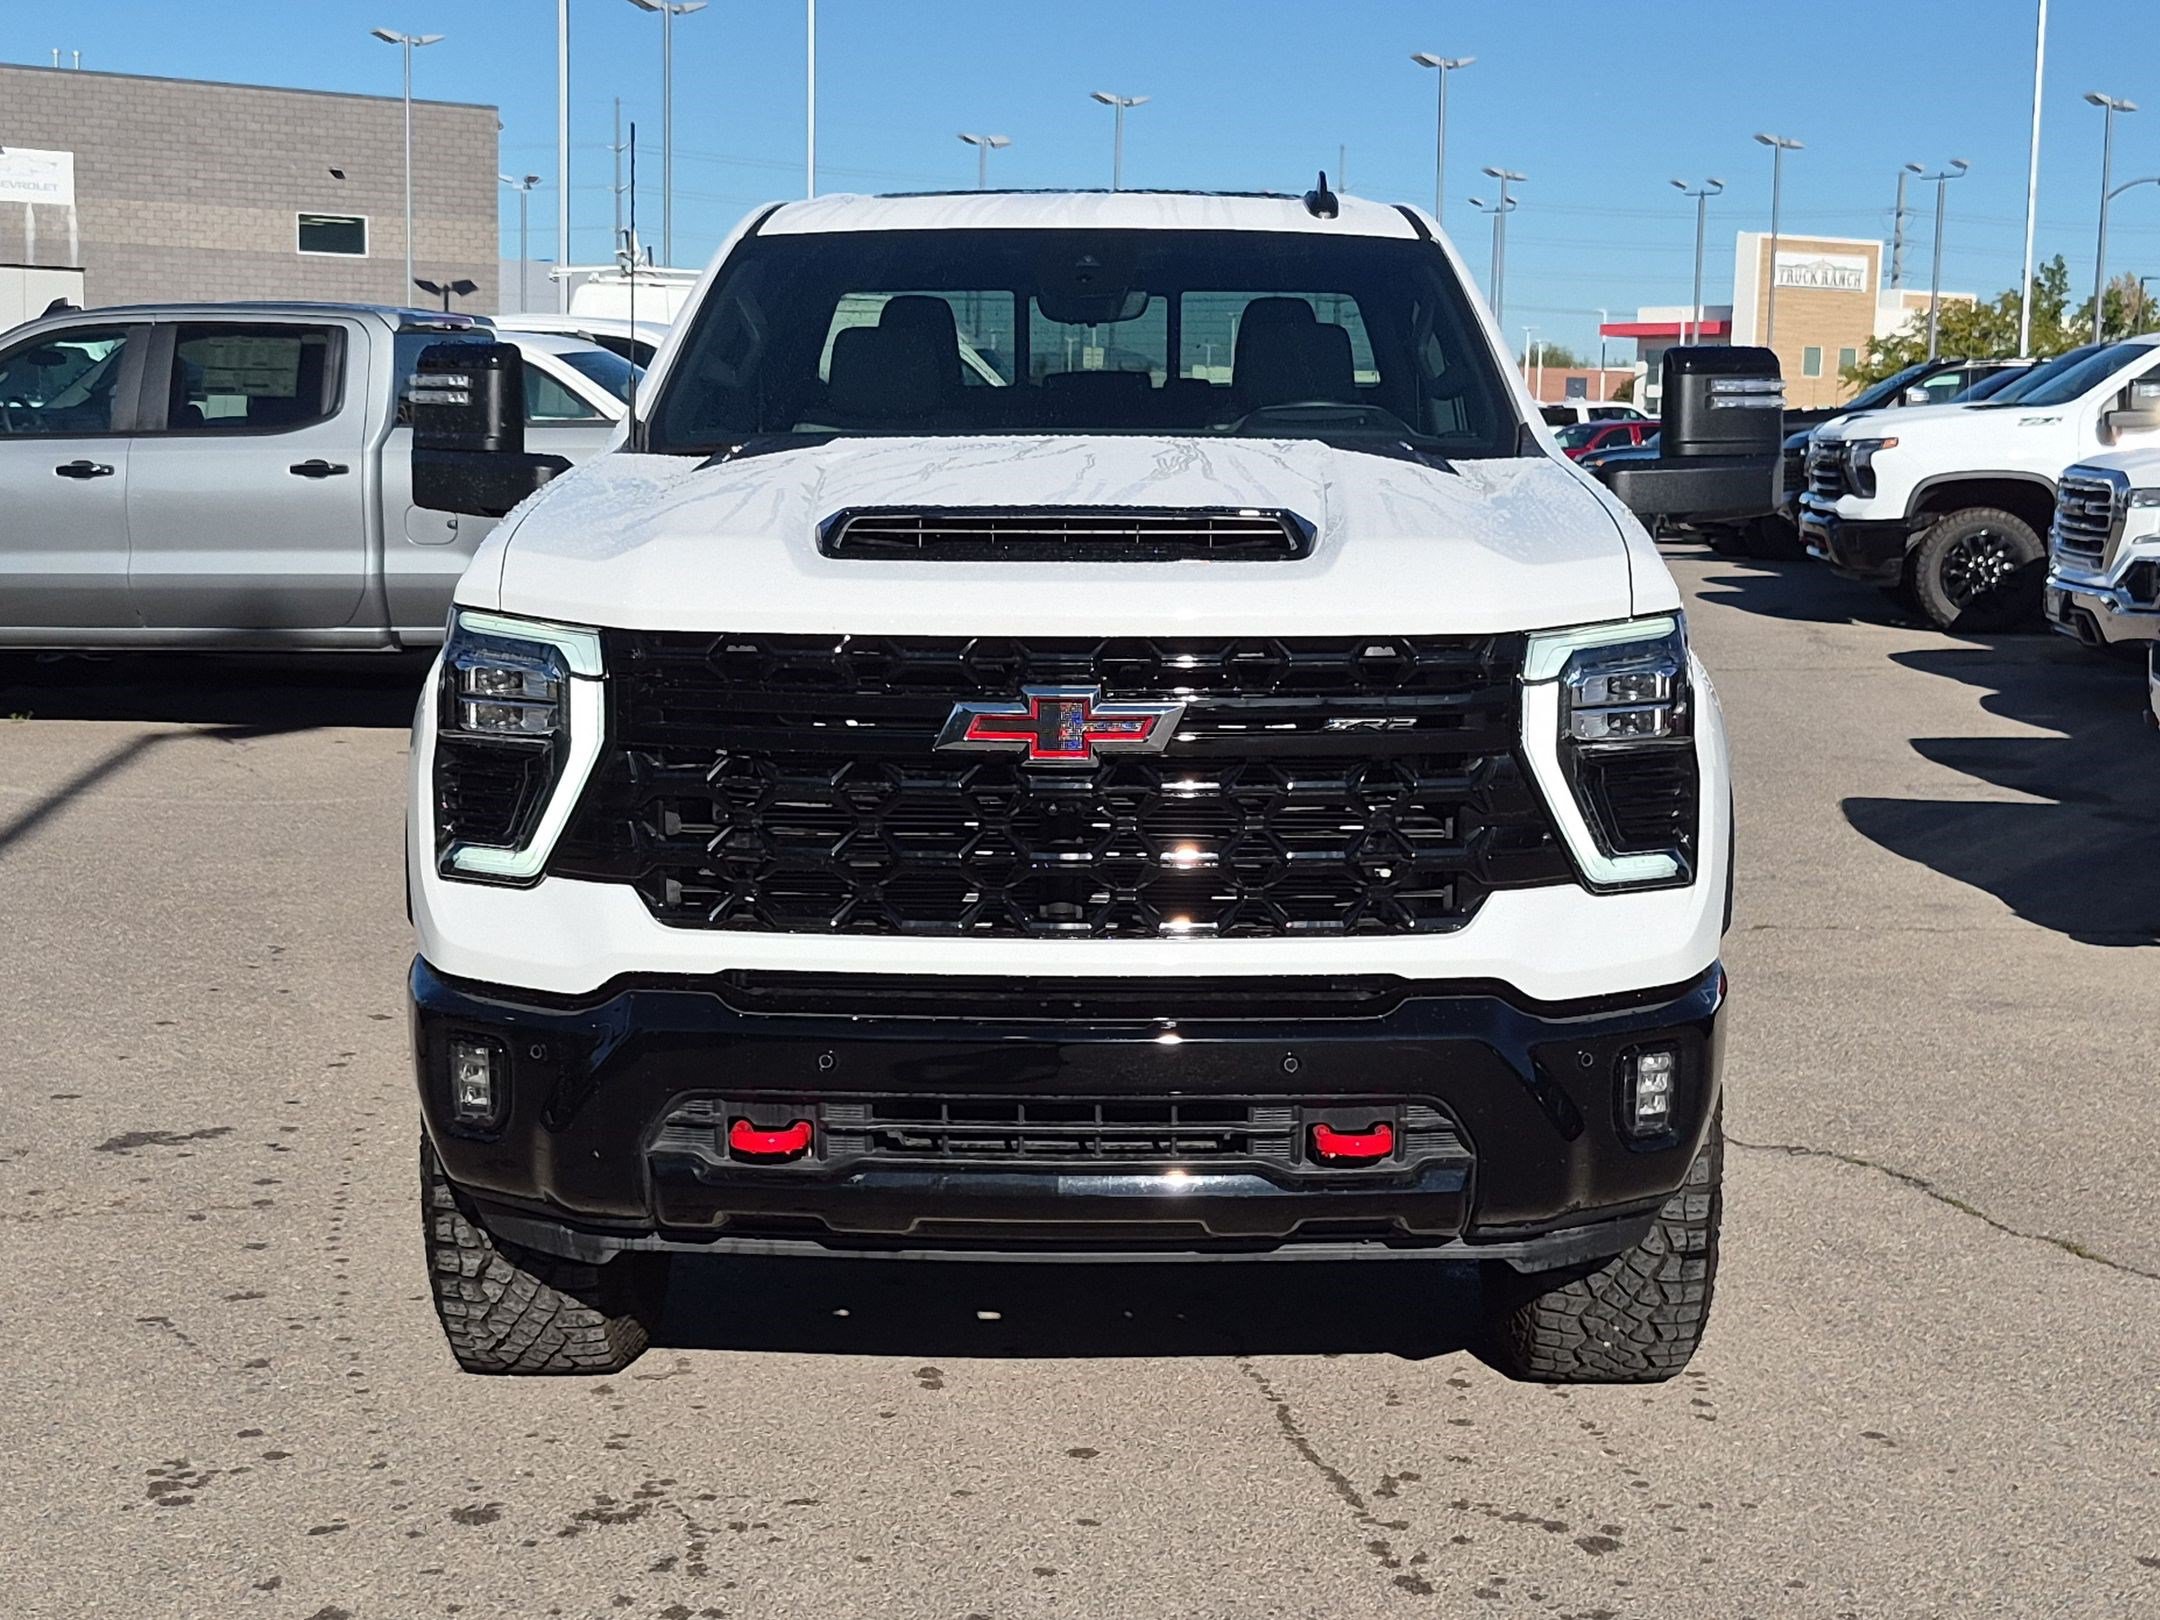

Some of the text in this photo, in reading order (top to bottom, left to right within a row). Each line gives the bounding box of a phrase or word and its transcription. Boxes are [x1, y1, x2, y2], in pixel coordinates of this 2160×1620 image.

[1779, 268, 1862, 288] TRUCK RANCH
[1323, 718, 1418, 731] ZR2
